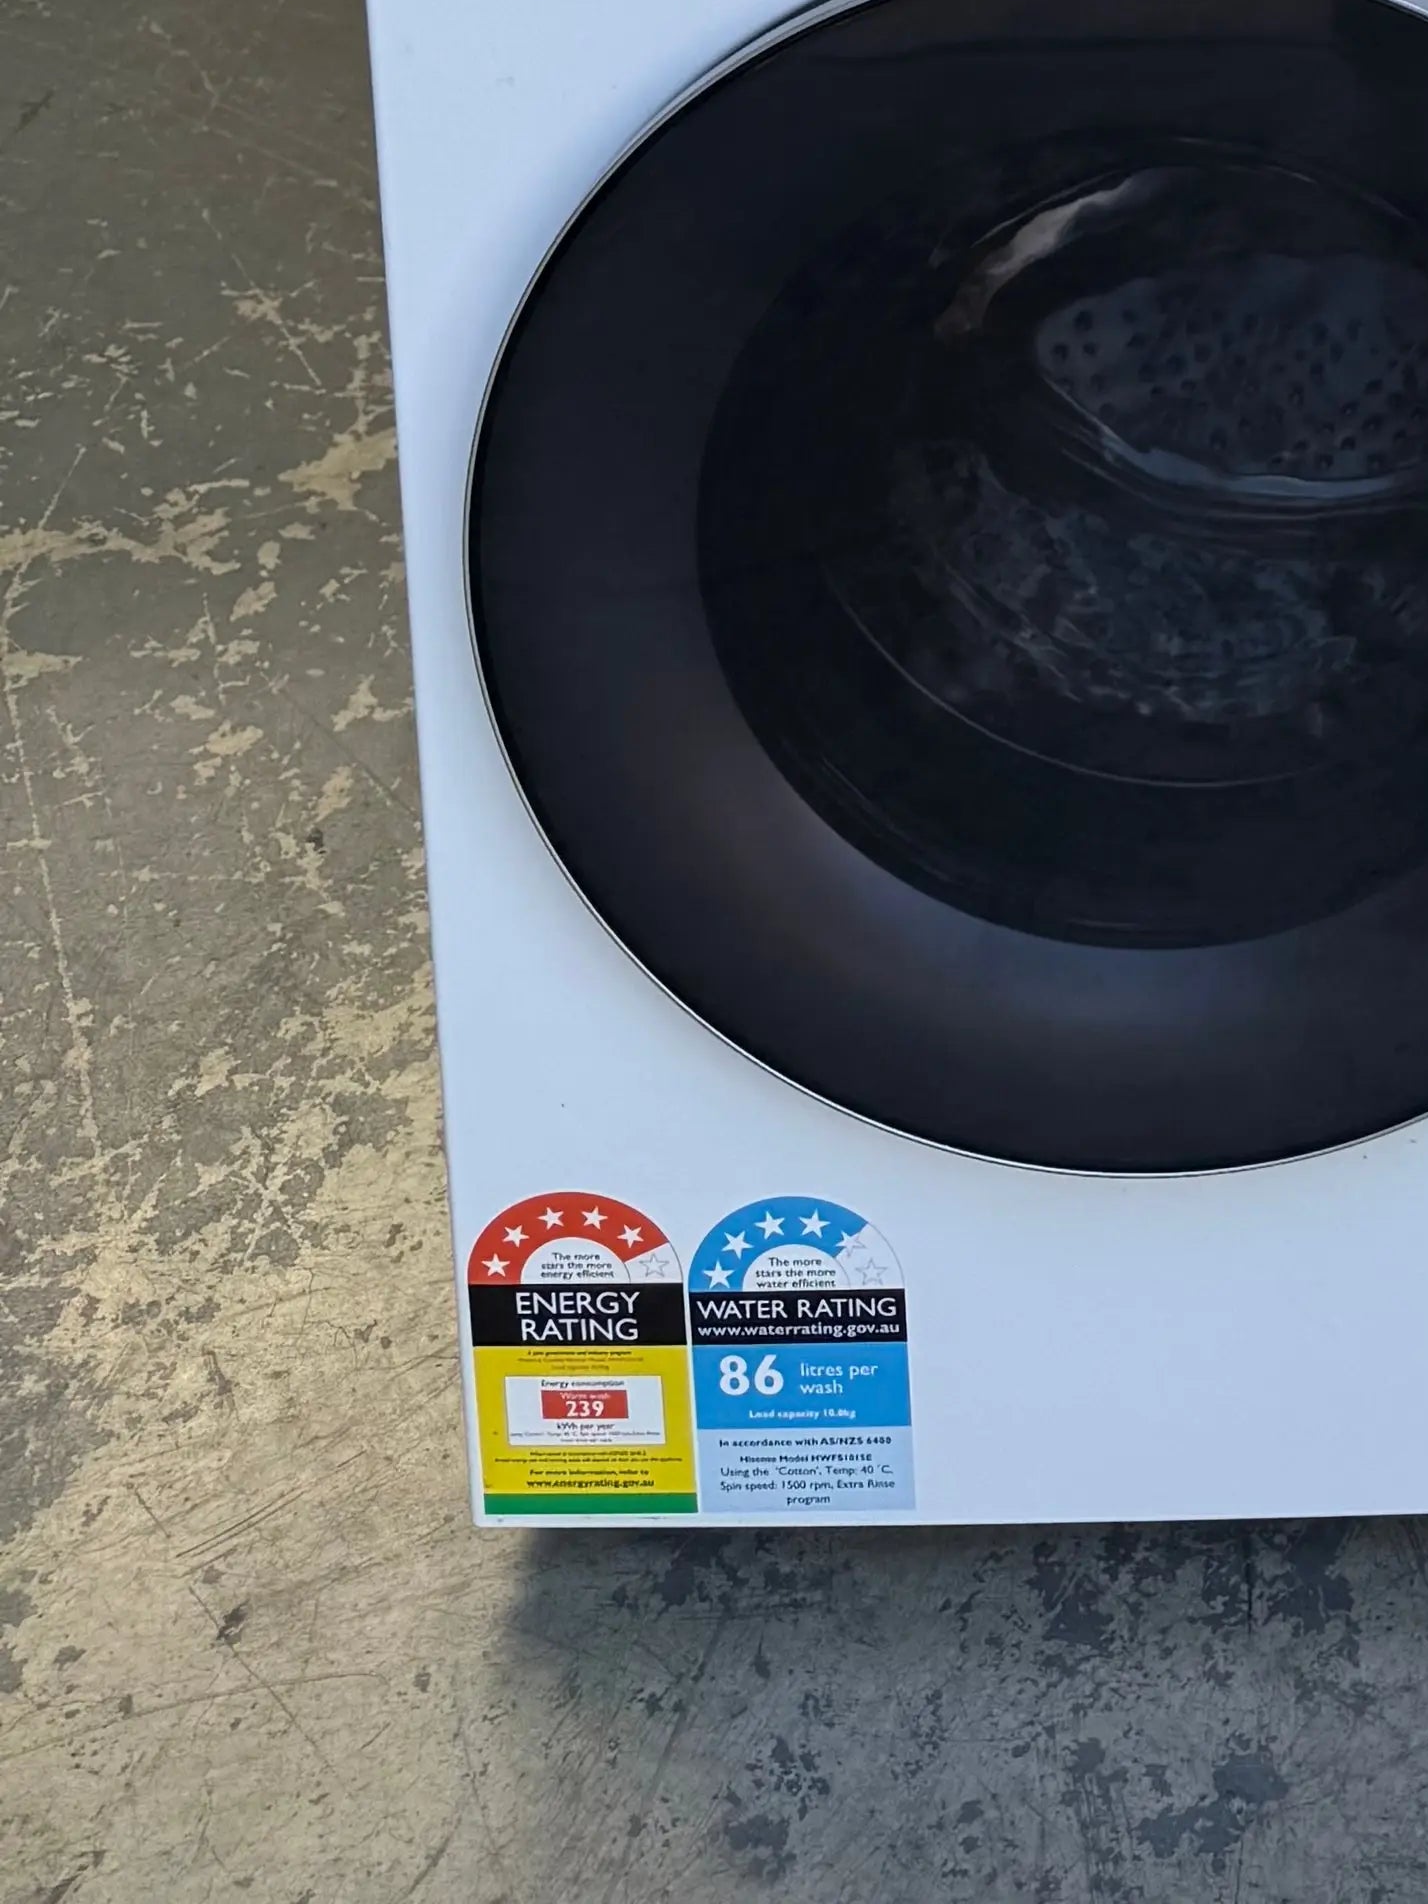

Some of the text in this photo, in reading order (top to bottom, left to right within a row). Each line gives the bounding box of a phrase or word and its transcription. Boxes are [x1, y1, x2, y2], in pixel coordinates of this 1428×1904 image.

[768, 1257, 790, 1266] The
[541, 1270, 614, 1280] energy efficient
[756, 1270, 781, 1278] stars
[786, 1269, 804, 1277] the
[515, 1293, 640, 1314] ENERGY
[696, 1298, 897, 1319] WATER RATING
[520, 1319, 639, 1341] RATING
[698, 1321, 900, 1338] www.waterrating.gov.au
[719, 1354, 878, 1396] 86 litres per
[800, 1380, 843, 1394] wash
[566, 1401, 605, 1417] 239
[720, 1467, 750, 1478] Using
[752, 1466, 769, 1476] the
[860, 1465, 874, 1474] 40
[720, 1481, 742, 1493] Spin
[782, 1481, 806, 1490] 1500
[837, 1480, 864, 1489] Extra
[867, 1479, 895, 1489] Rinse
[786, 1495, 831, 1506] program
